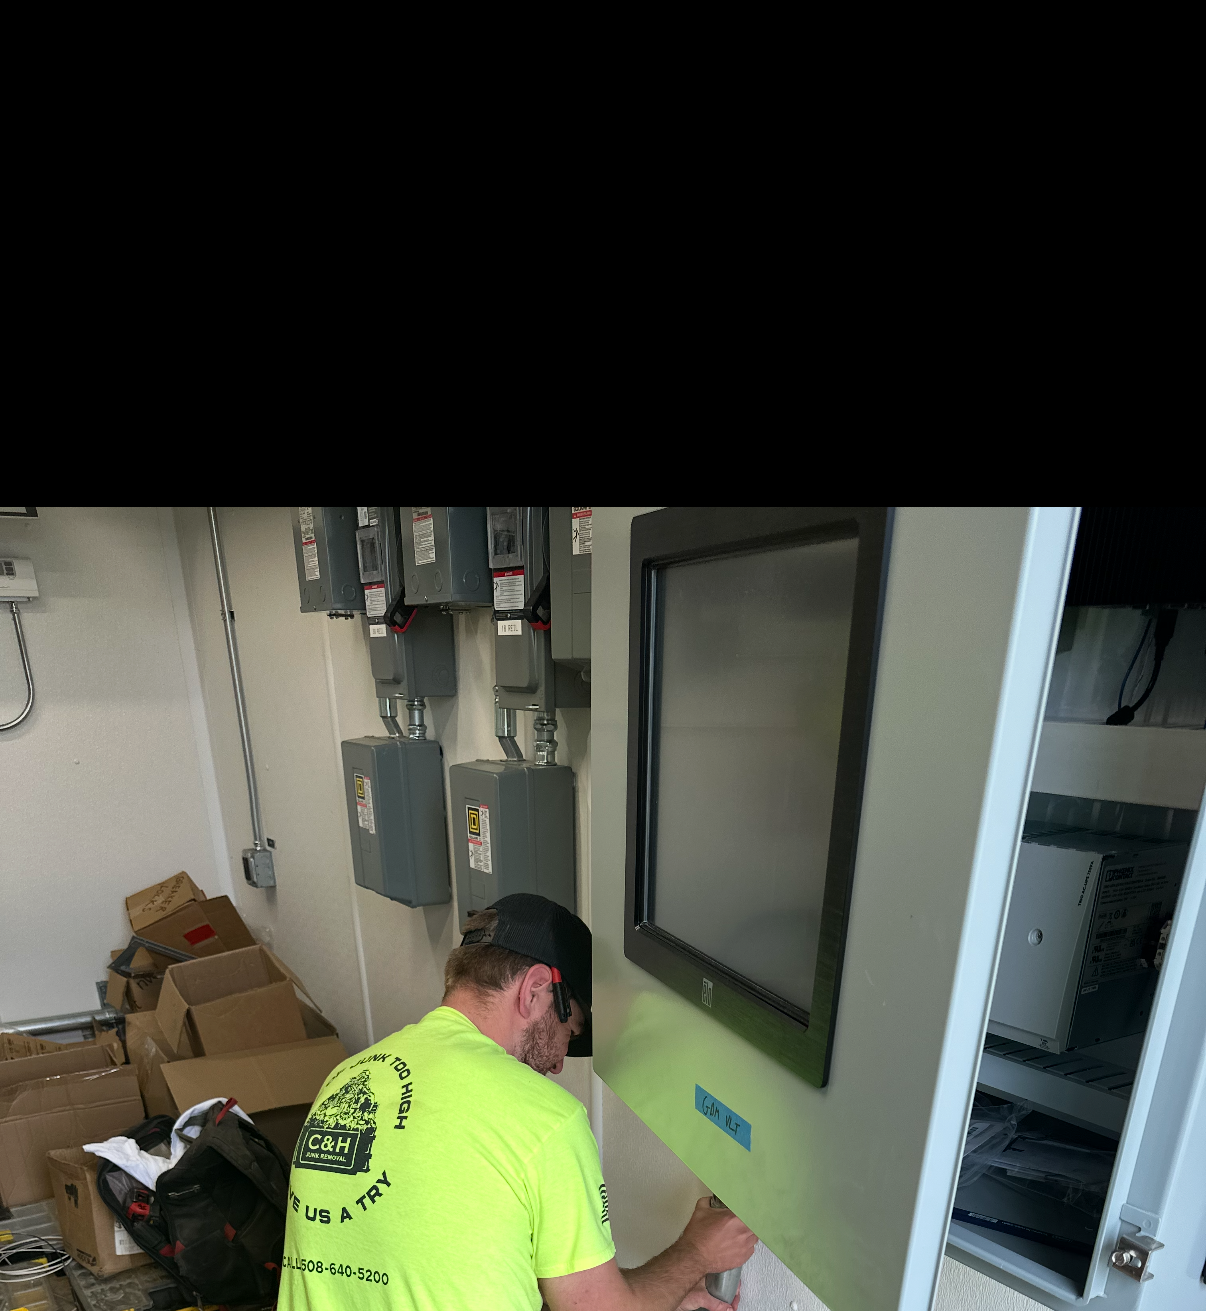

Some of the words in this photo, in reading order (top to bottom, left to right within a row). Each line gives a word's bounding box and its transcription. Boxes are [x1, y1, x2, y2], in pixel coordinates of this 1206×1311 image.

[389, 1056, 411, 1080] TOO
[393, 1082, 413, 1130] HIGH
[308, 1134, 351, 1154] C&H
[320, 1153, 347, 1162] REMOVAL
[305, 1205, 331, 1225] US
[340, 1206, 353, 1223] A
[355, 1170, 391, 1211] TRY
[301, 1258, 389, 1285] 508-640-5200
